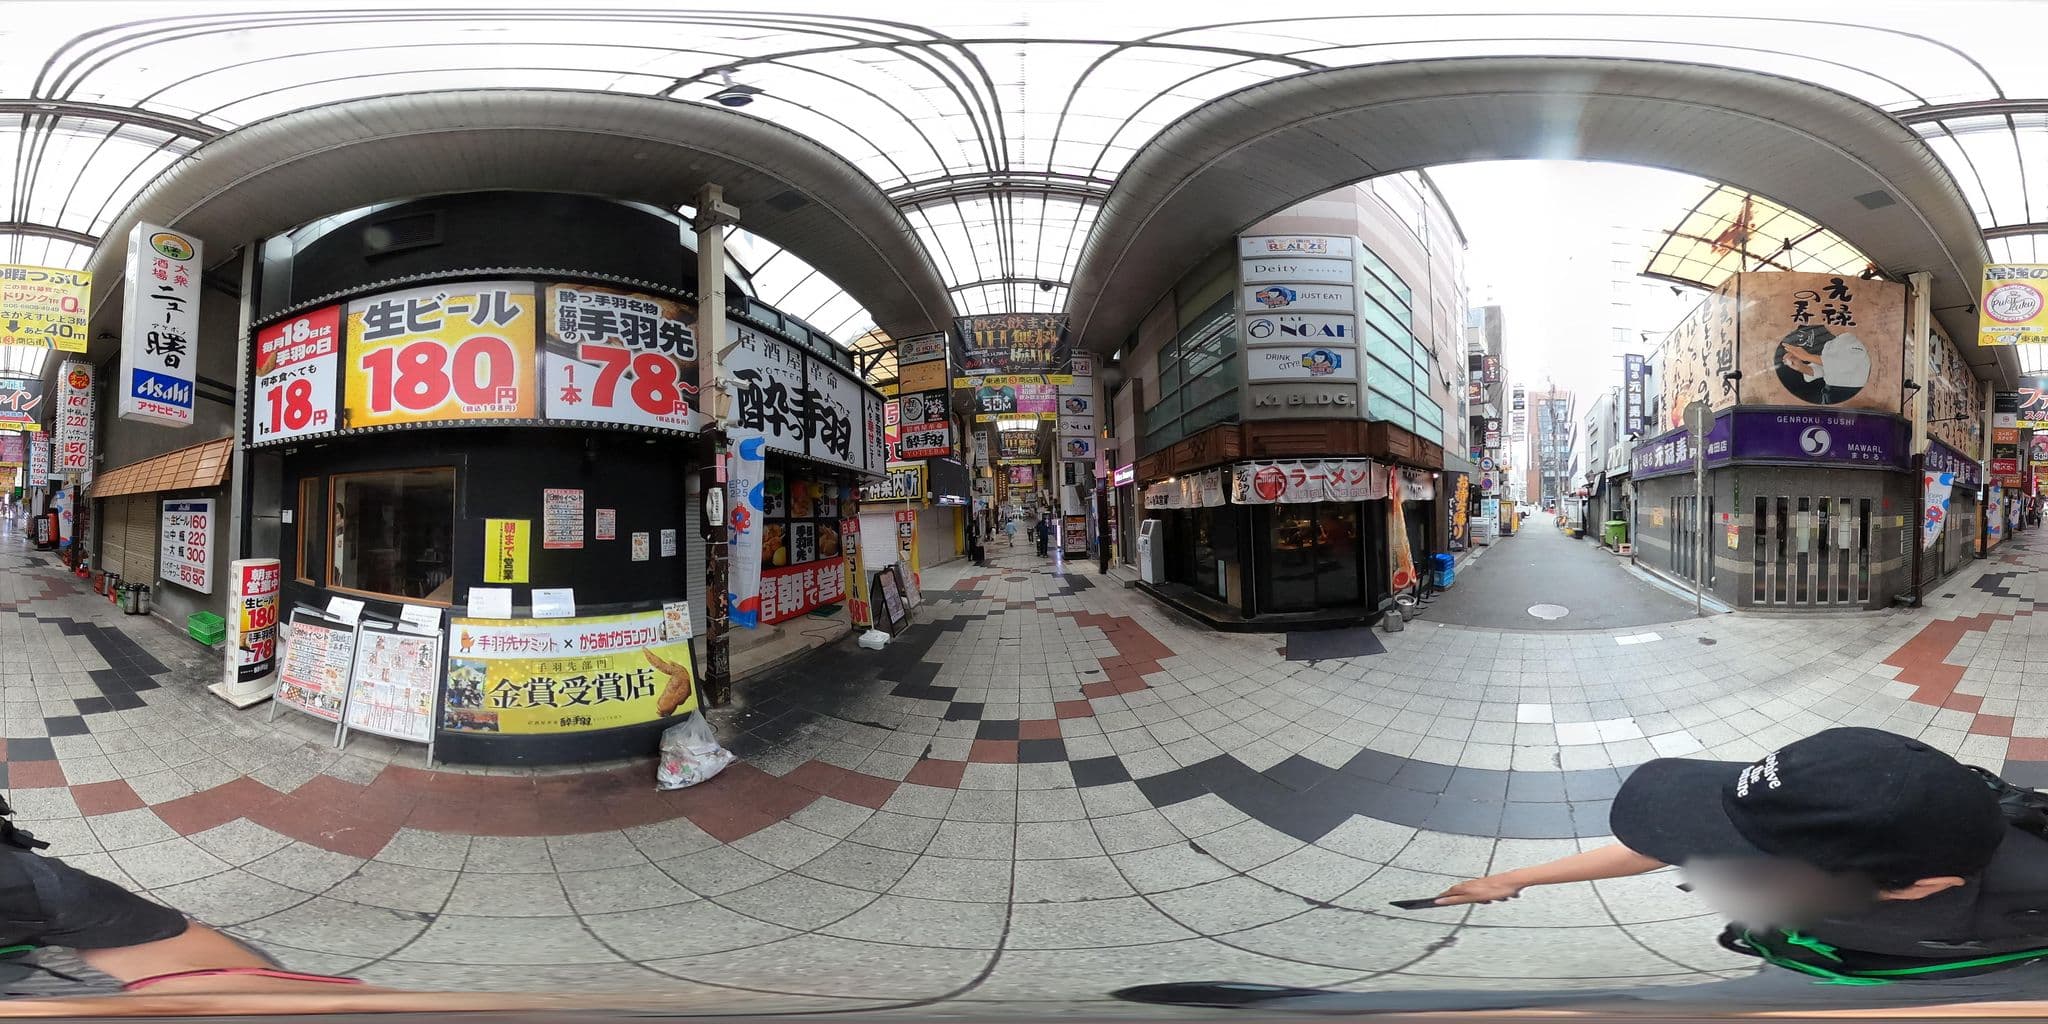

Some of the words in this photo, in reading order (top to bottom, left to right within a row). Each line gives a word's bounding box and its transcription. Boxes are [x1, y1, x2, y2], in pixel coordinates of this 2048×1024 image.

[1269, 243, 1326, 251] REALIZE
[0, 267, 90, 287] 暇つぶし
[153, 257, 169, 281] 酒場
[174, 264, 190, 288] 大衆
[1255, 264, 1298, 274] Deity
[1822, 277, 1857, 327] 元禄
[363, 291, 521, 342] 生ビール
[559, 305, 578, 341] 伝説の
[25, 323, 86, 340] あと40m
[262, 319, 332, 354] 毎月18日は
[577, 307, 696, 359] 手羽先
[1281, 324, 1353, 338] NOAH
[276, 338, 332, 366] 手羽の日
[1265, 353, 1291, 361] DRINK
[261, 364, 317, 388] 何本食べても
[560, 364, 582, 406] 1本
[138, 376, 189, 404] Asahi
[1288, 392, 1356, 406] BLDG.
[0, 390, 42, 411] イン
[68, 396, 88, 408] 160
[267, 378, 328, 434] 18円
[138, 401, 188, 419] アサヒビール
[66, 416, 88, 427] 220
[1776, 415, 1821, 425] GENROKU
[1827, 417, 1856, 426] SUSHI
[69, 454, 87, 468] 90
[1850, 453, 1880, 461] まわる
[1289, 468, 1367, 488] ラーメン
[189, 514, 207, 529] 160
[187, 531, 207, 547] 220
[186, 547, 206, 564] 300
[503, 521, 516, 581] 朝まで営業
[180, 570, 192, 583] 50
[192, 573, 205, 587] 90
[250, 568, 279, 581] 朝まで
[246, 579, 279, 594] 営業中
[245, 596, 274, 610] 生ビール
[248, 604, 276, 629] 180
[478, 633, 558, 653] 手羽先サミット
[579, 625, 659, 651] からあげグランプリ
[250, 638, 273, 663] 78
[539, 659, 607, 673] 手羽先部門
[488, 668, 657, 709] 金賞受賞店
